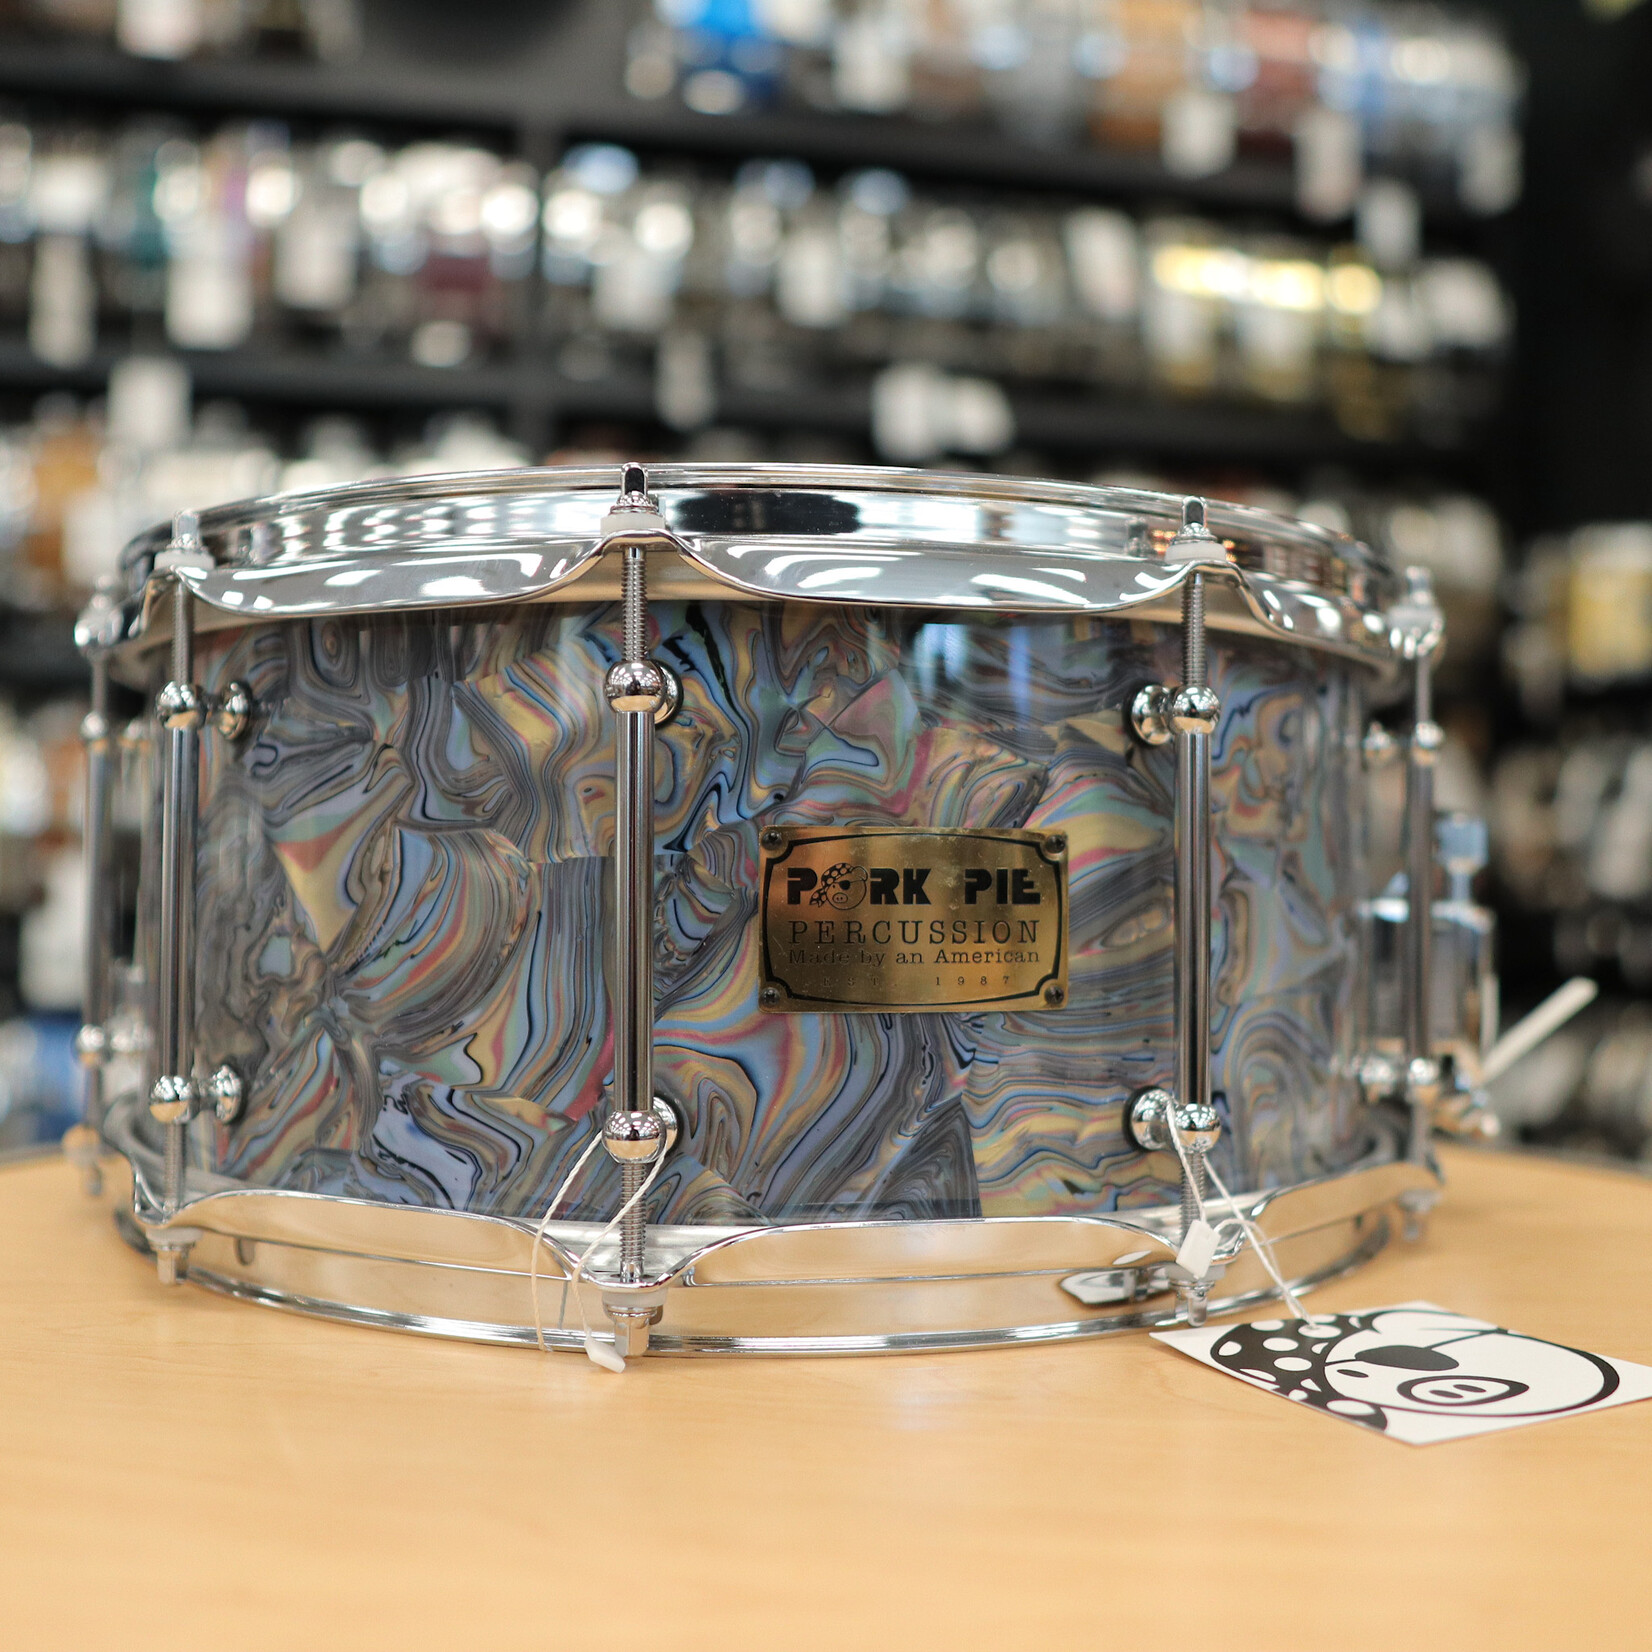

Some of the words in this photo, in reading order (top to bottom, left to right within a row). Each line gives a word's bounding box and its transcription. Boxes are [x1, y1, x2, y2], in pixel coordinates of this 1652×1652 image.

[964, 868, 1041, 905] PIE
[788, 920, 1040, 944] PERCUSSION
[788, 950, 849, 964] Made
[861, 949, 885, 966] by
[896, 952, 923, 964] an
[934, 949, 1040, 964] American
[936, 976, 1010, 986] 1987
